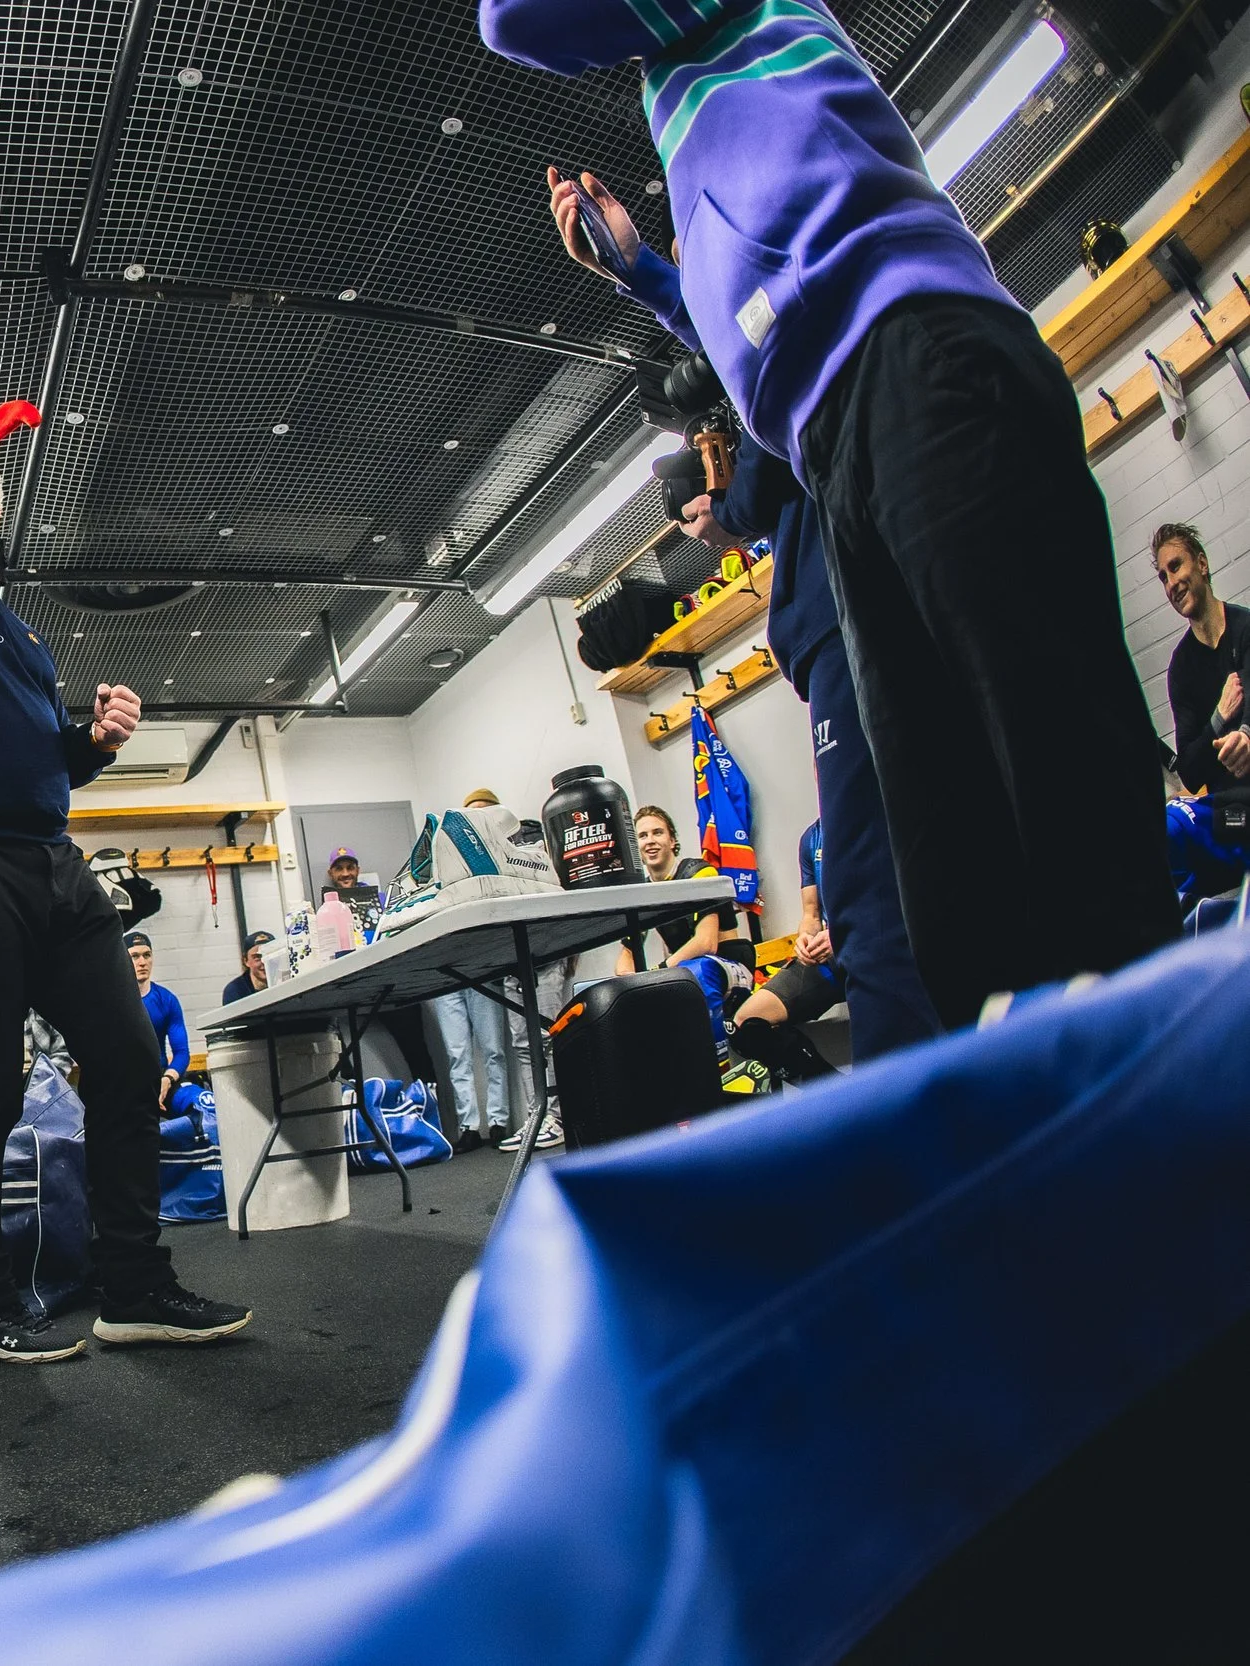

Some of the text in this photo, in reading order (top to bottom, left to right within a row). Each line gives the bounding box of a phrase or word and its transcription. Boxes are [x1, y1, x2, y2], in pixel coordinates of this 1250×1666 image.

[564, 823, 606, 844] AFTER
[564, 834, 612, 852] FOR RECOVERY
[506, 856, 549, 872] WARRIOR
